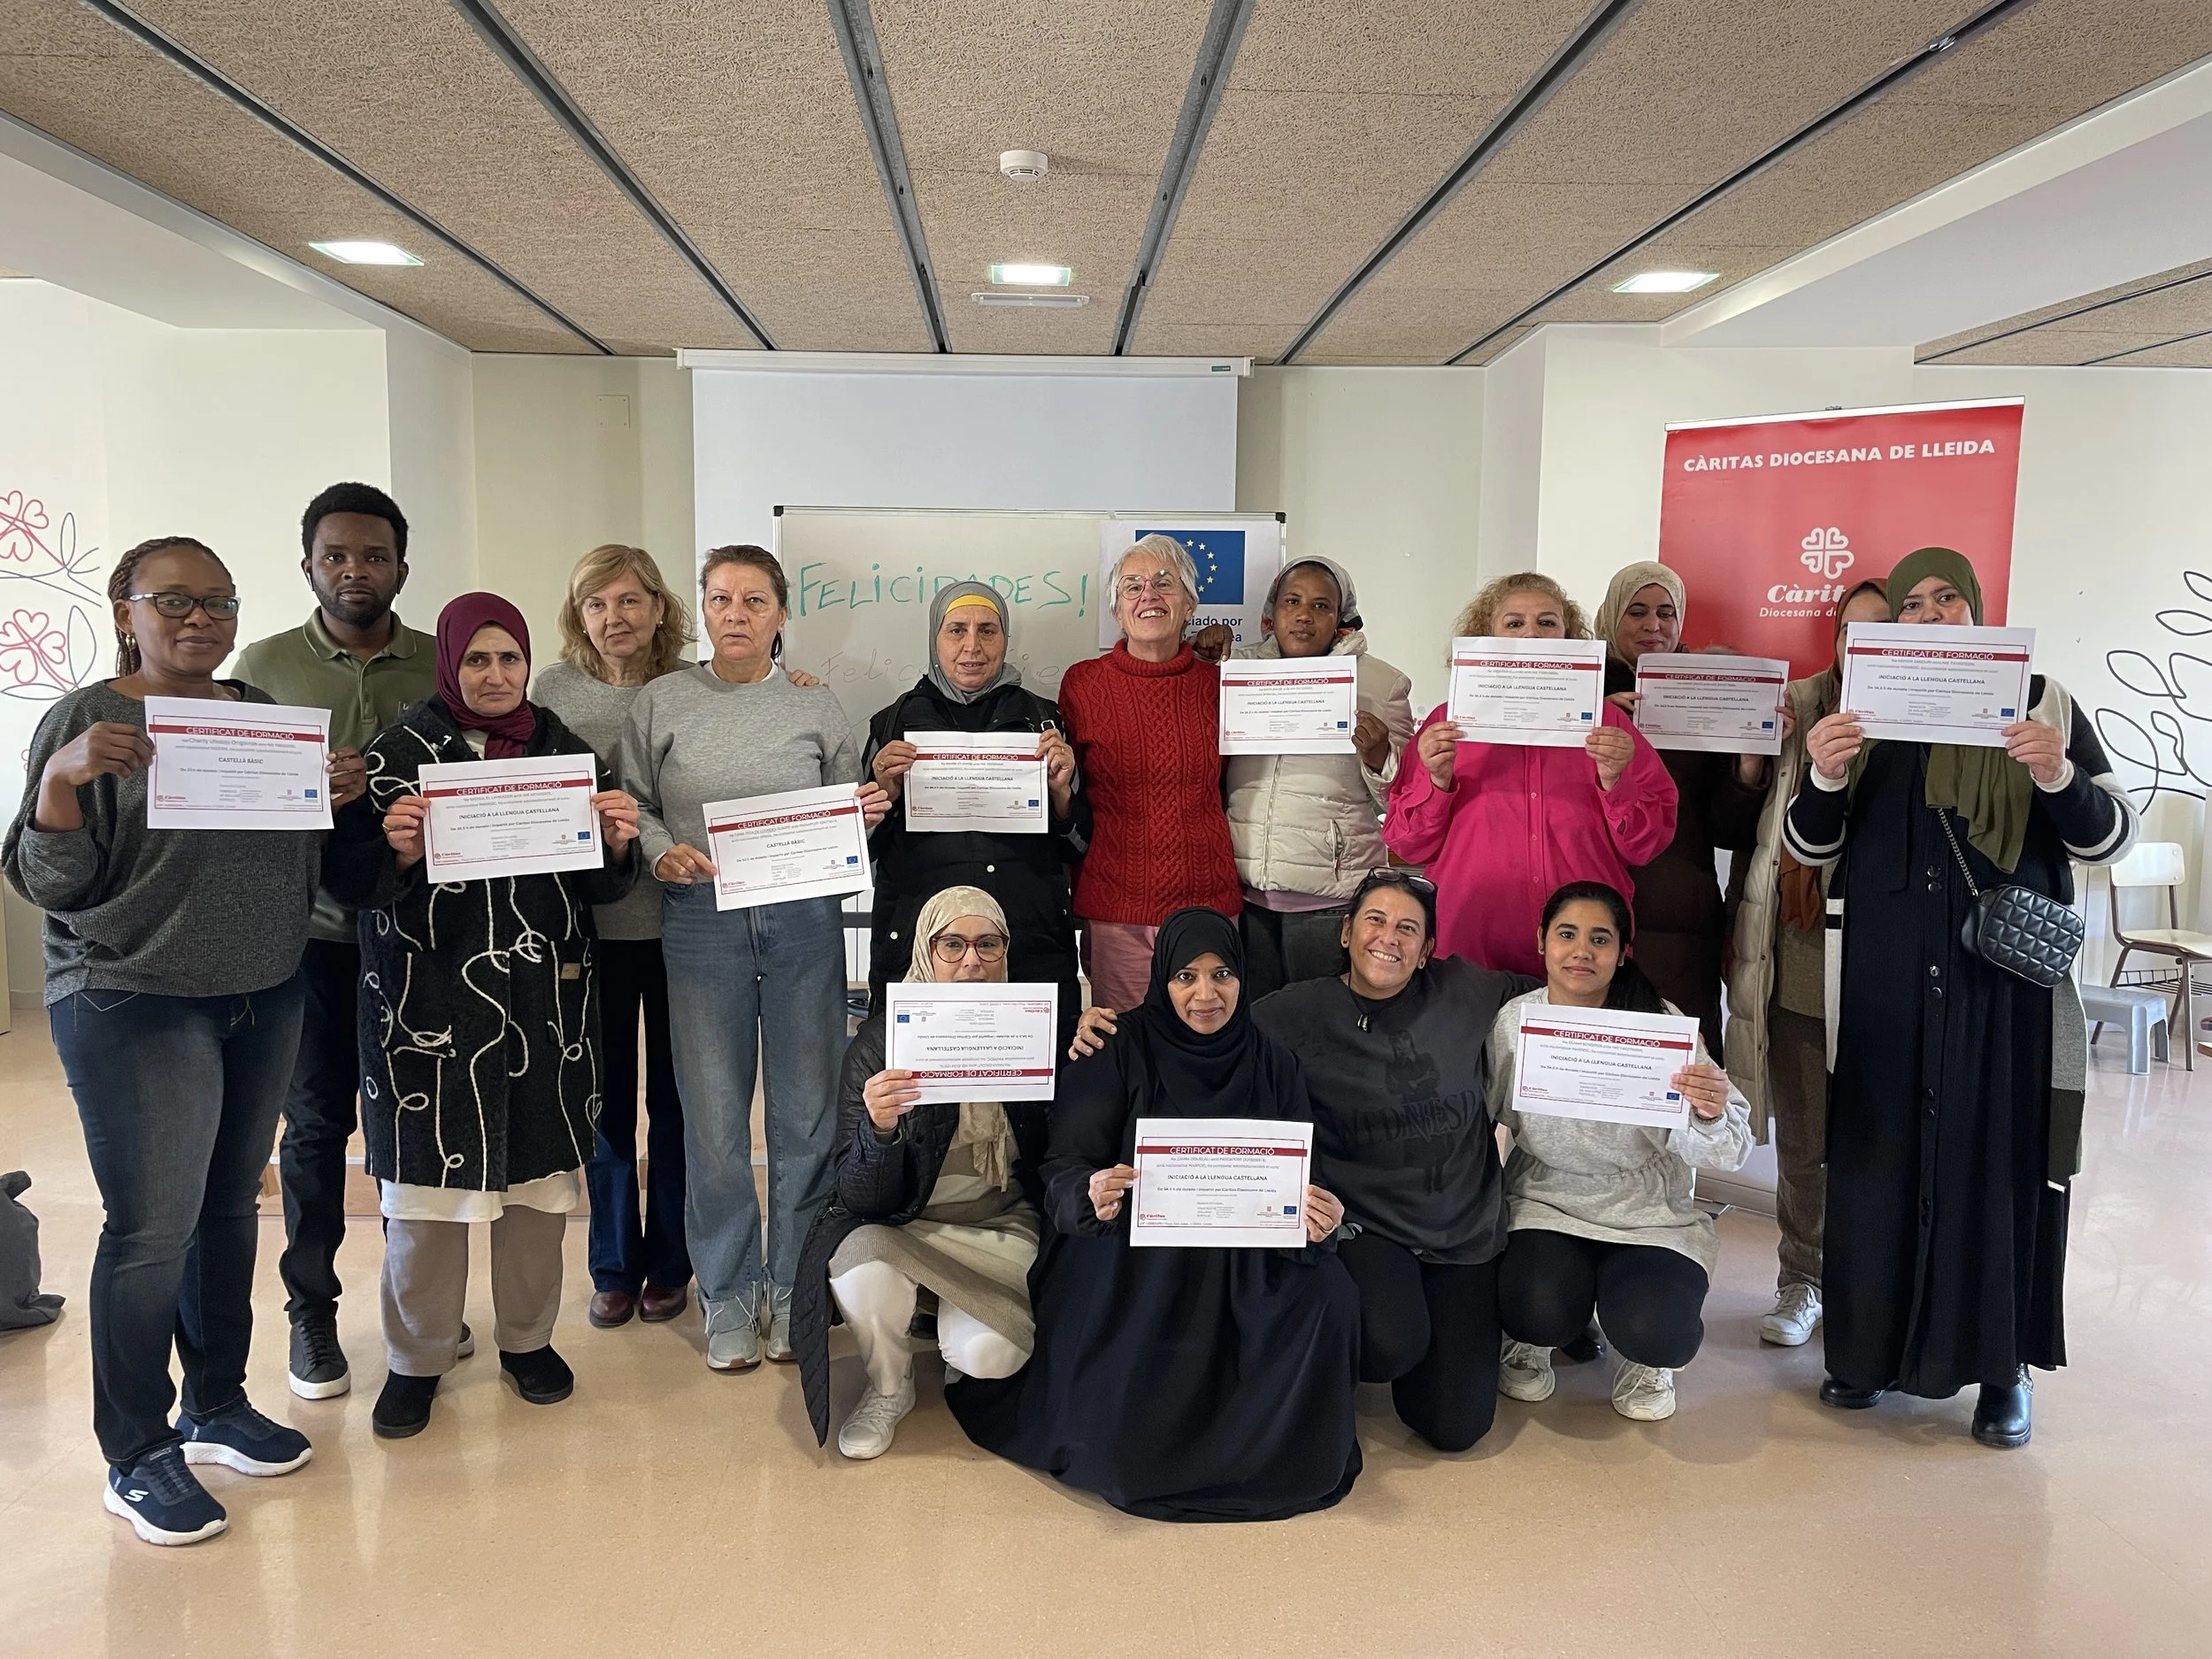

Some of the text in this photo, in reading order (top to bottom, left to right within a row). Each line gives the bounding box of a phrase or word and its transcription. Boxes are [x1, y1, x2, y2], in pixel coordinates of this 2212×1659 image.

[1683, 439, 1995, 472] CÀRITAS DIOCESANA DE LLEIDA
[1767, 583, 1846, 603] Càrit
[1759, 606, 1821, 618] Diocesana
[1222, 618, 1243, 626] por
[1881, 649, 1930, 657] CERTIFICAT
[1946, 650, 1993, 660] FORMACIÓ
[185, 726, 234, 736] CERTIFICAT
[250, 729, 294, 740] FORMACIÓ
[456, 785, 503, 795] CERTIFICAT
[518, 780, 562, 791] FORMACIÓ
[737, 817, 778, 829] CERTIFICAT
[791, 809, 831, 822] FORMACIÓ
[1553, 1030, 1599, 1041] CERTIFICAT
[1615, 1035, 1660, 1047] FORMACIÓ
[1231, 1147, 1274, 1156] FORMACIÓ
